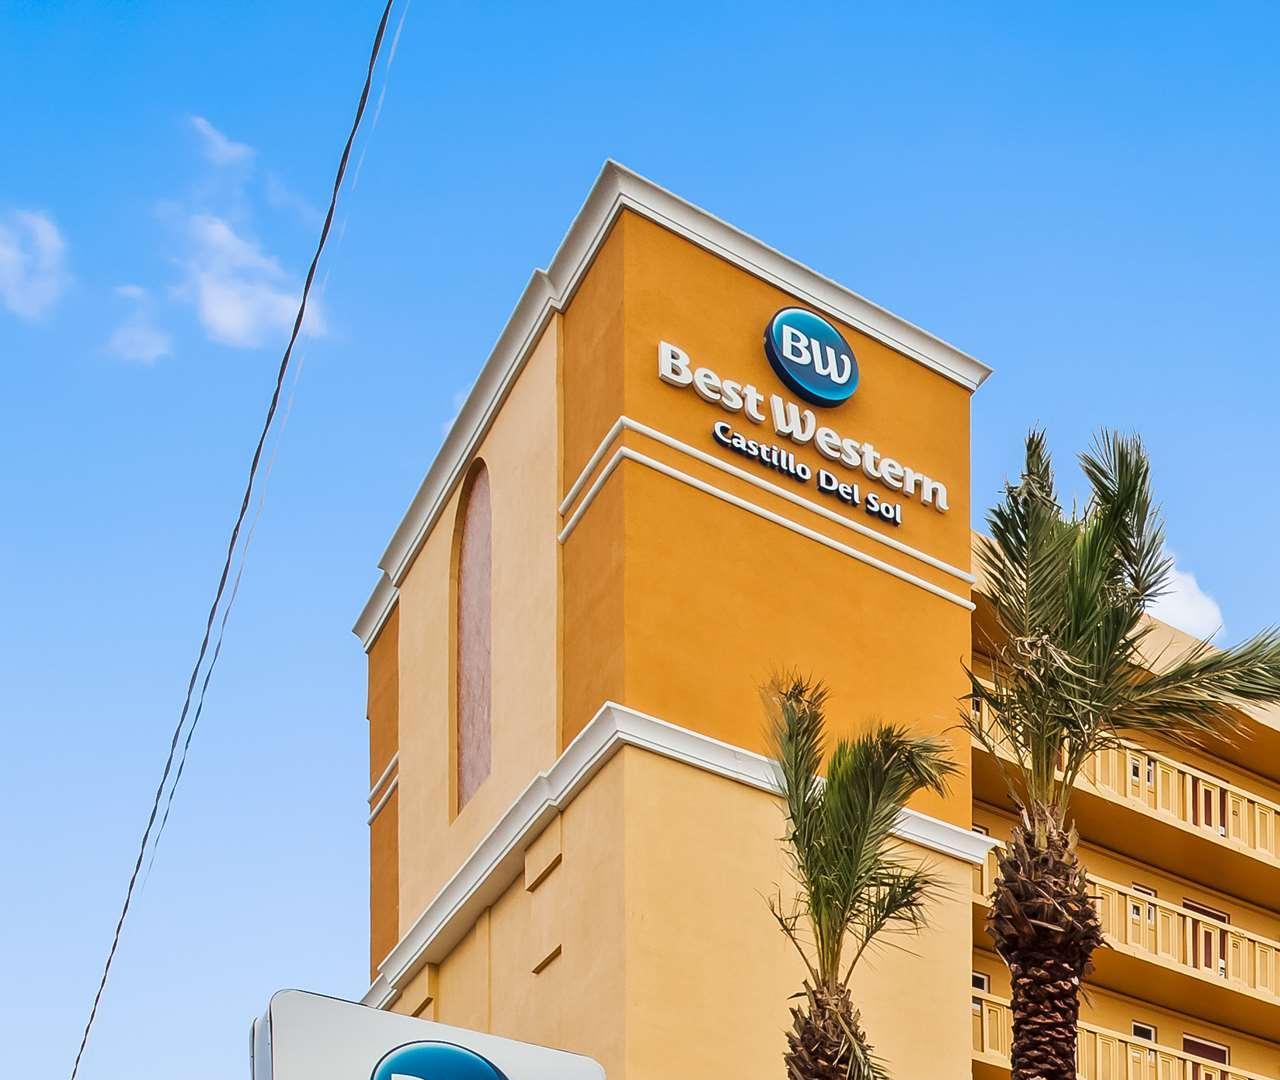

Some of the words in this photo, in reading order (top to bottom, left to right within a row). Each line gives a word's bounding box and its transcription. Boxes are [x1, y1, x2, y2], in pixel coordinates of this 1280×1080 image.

[781, 324, 852, 385] BW
[658, 340, 766, 424] Best
[769, 393, 950, 514] Western
[712, 420, 812, 483] Castillo
[817, 468, 860, 507] Del
[866, 493, 902, 527] Sol
